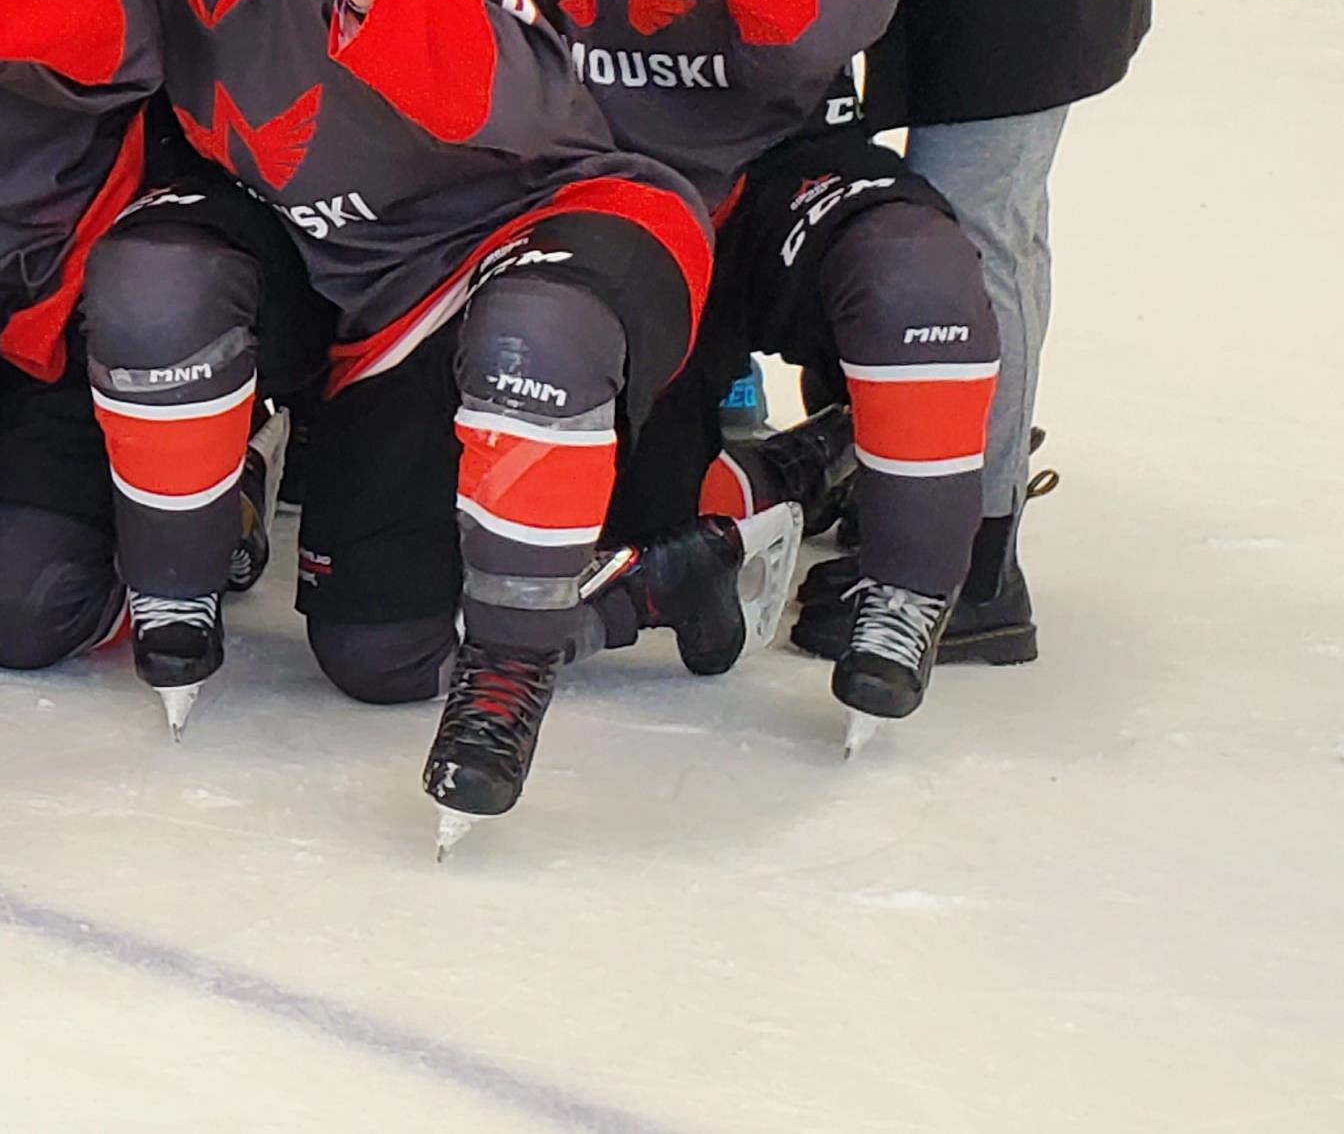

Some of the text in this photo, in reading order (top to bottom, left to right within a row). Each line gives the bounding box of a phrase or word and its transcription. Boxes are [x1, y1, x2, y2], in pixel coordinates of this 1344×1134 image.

[274, 192, 379, 240] SKI
[903, 324, 970, 345] MNM
[148, 362, 213, 384] MNM
[496, 372, 568, 408] MNM
